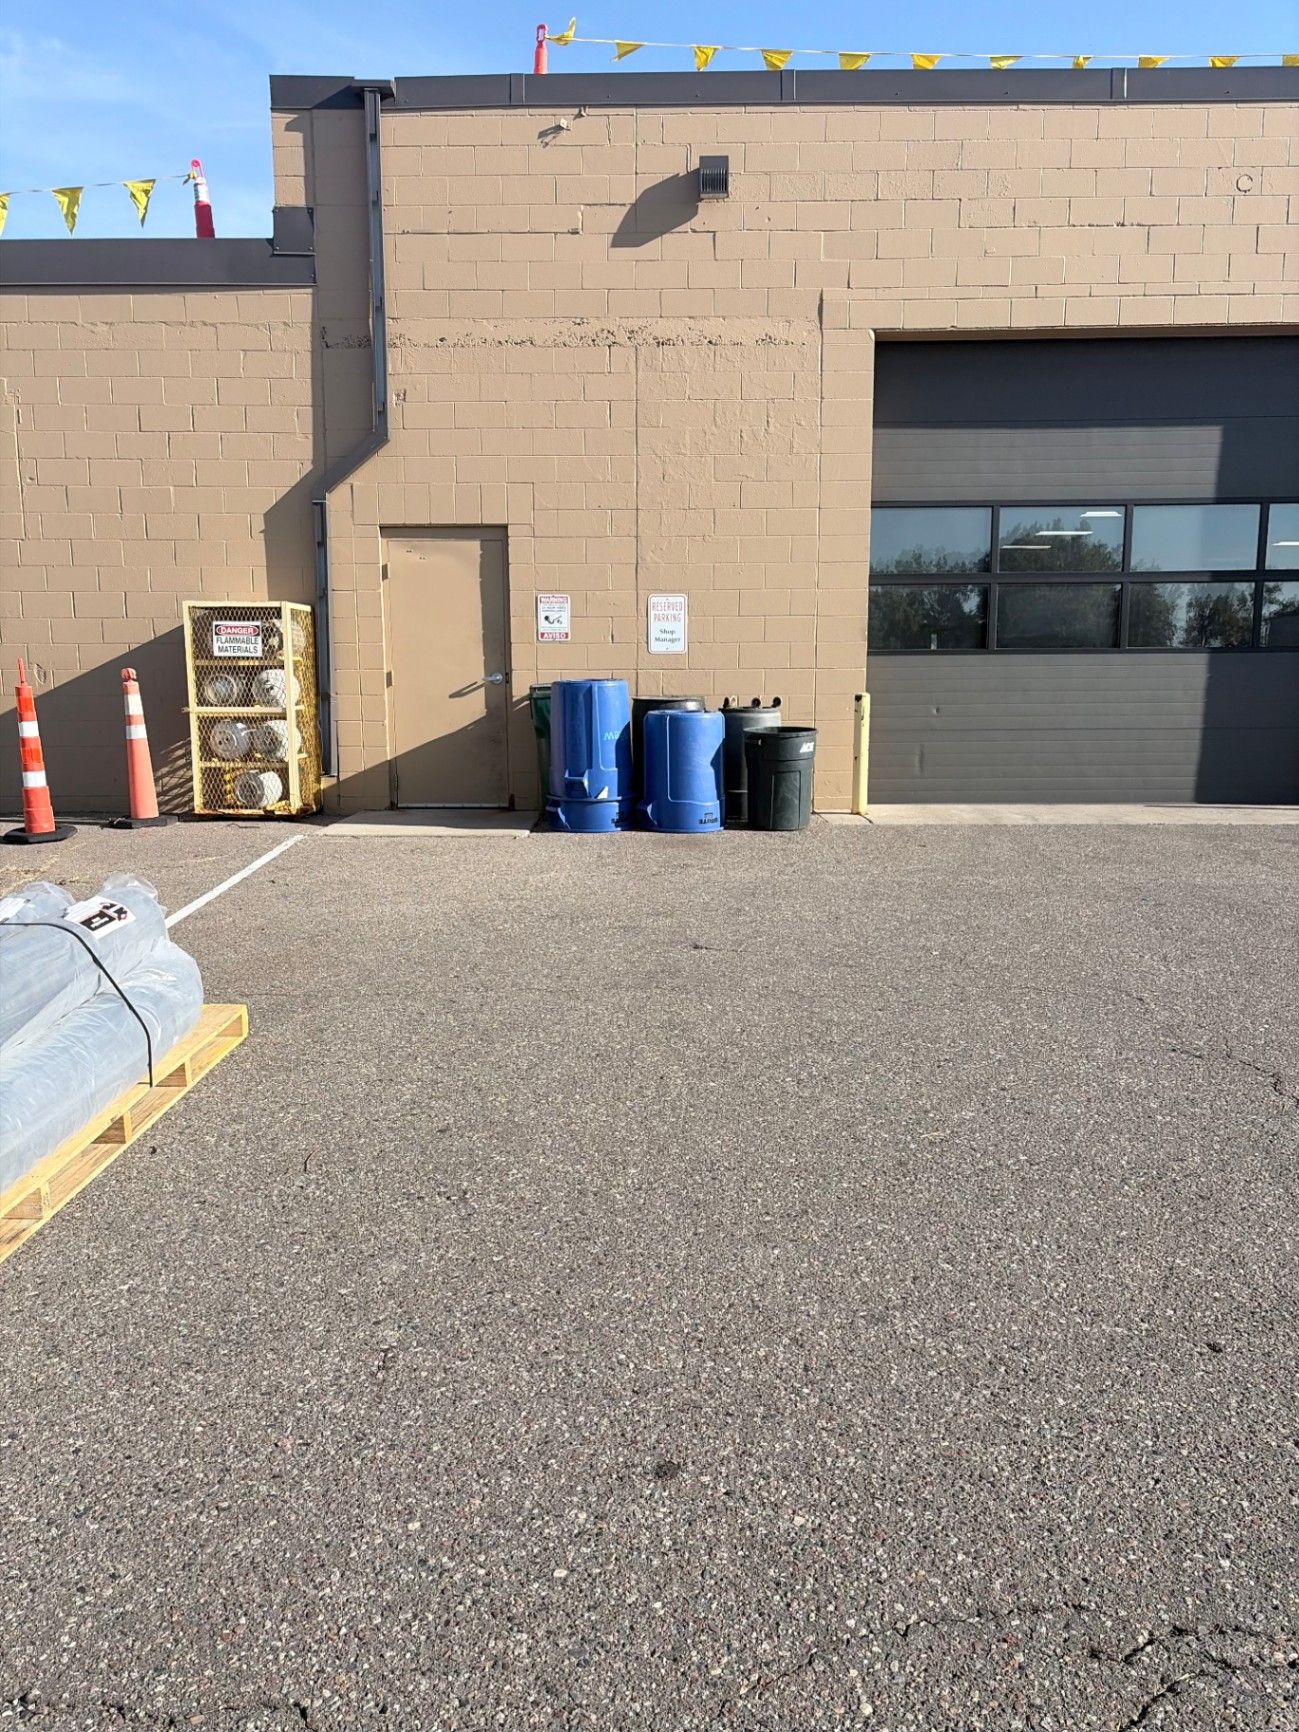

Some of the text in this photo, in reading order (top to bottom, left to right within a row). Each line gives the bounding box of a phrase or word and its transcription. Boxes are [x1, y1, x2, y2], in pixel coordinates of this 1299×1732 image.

[652, 601, 682, 611] RESERVED
[654, 613, 681, 622] PARKING
[220, 626, 253, 634] DANGER
[659, 628, 676, 636] Shop
[216, 636, 259, 645] FLAMMABLE
[654, 636, 681, 644] Manager
[218, 645, 258, 654] MATERIALS
